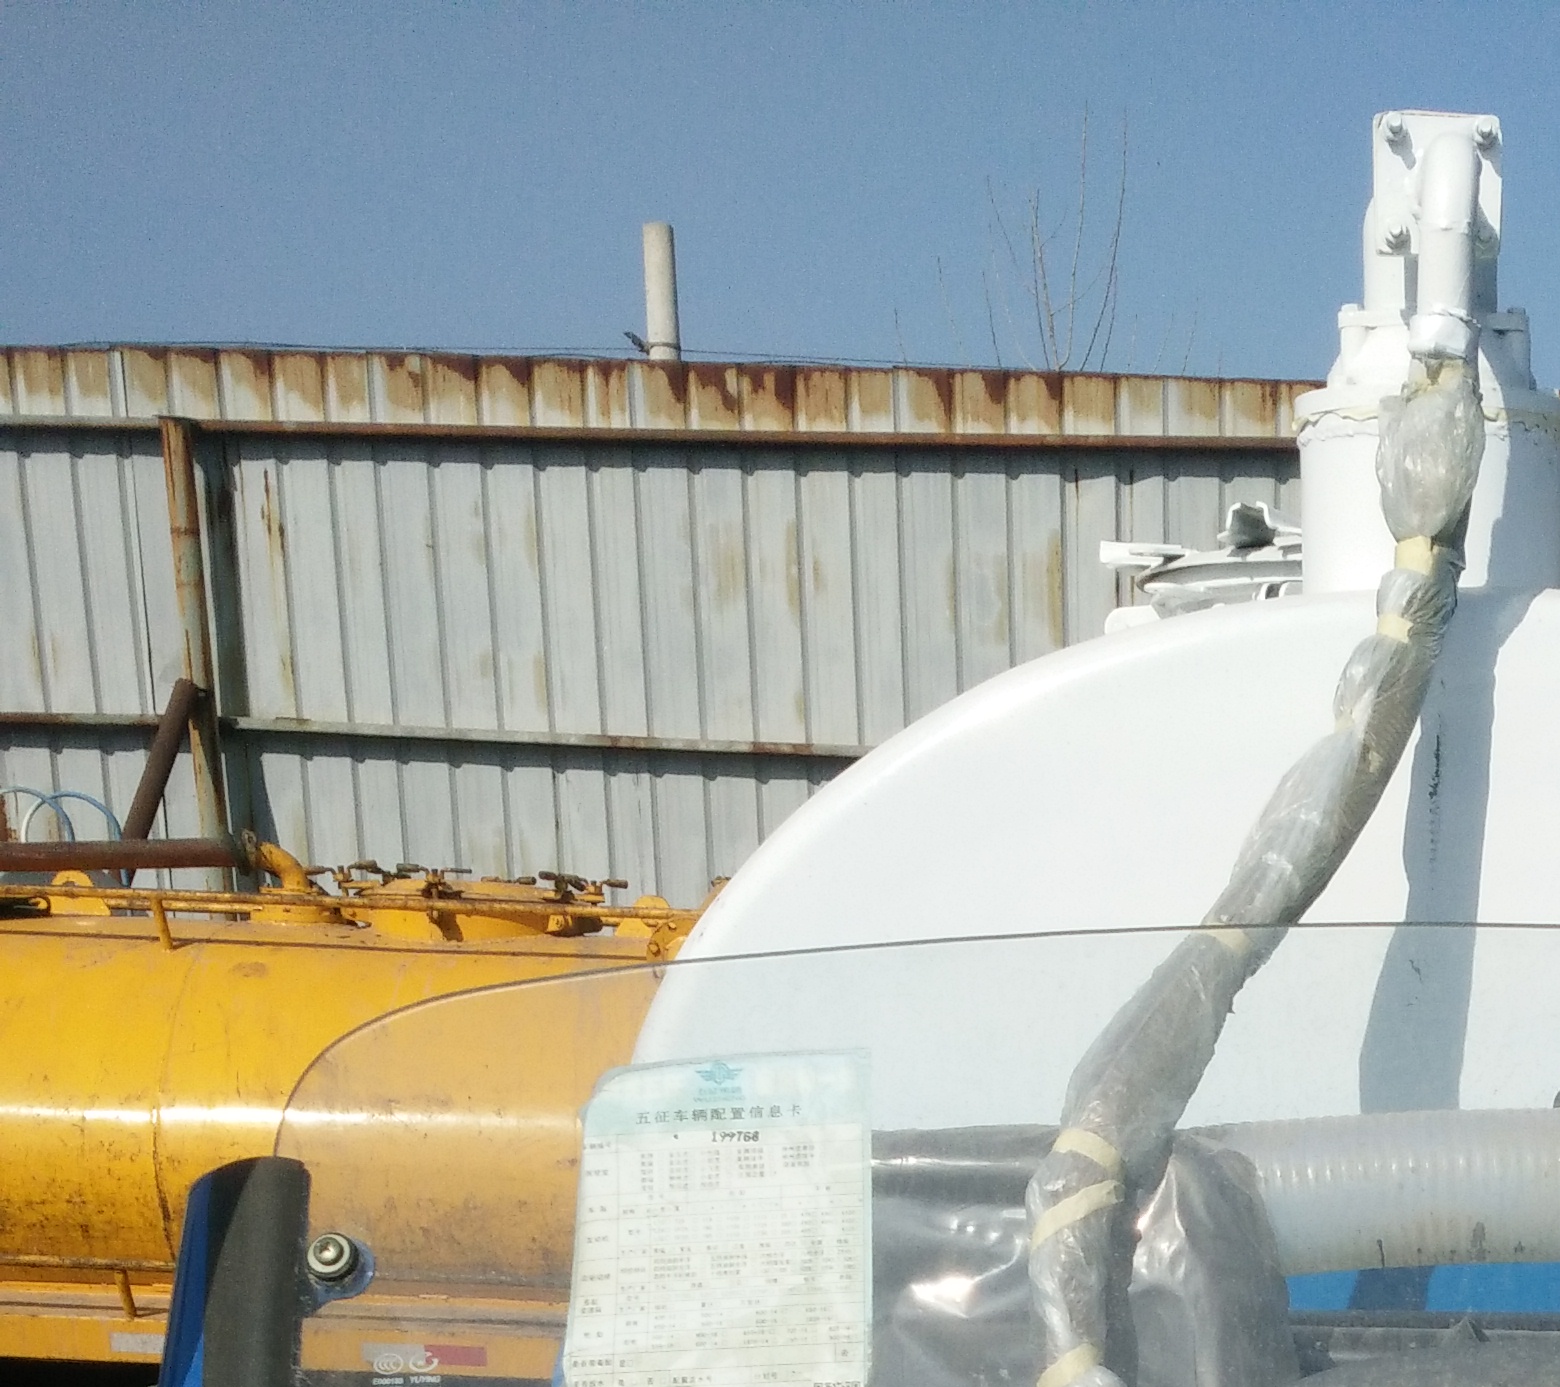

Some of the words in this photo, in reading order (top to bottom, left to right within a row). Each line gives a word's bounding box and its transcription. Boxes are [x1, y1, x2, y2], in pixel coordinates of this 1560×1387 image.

[636, 1104, 802, 1126] 五征车辆配置信息卡
